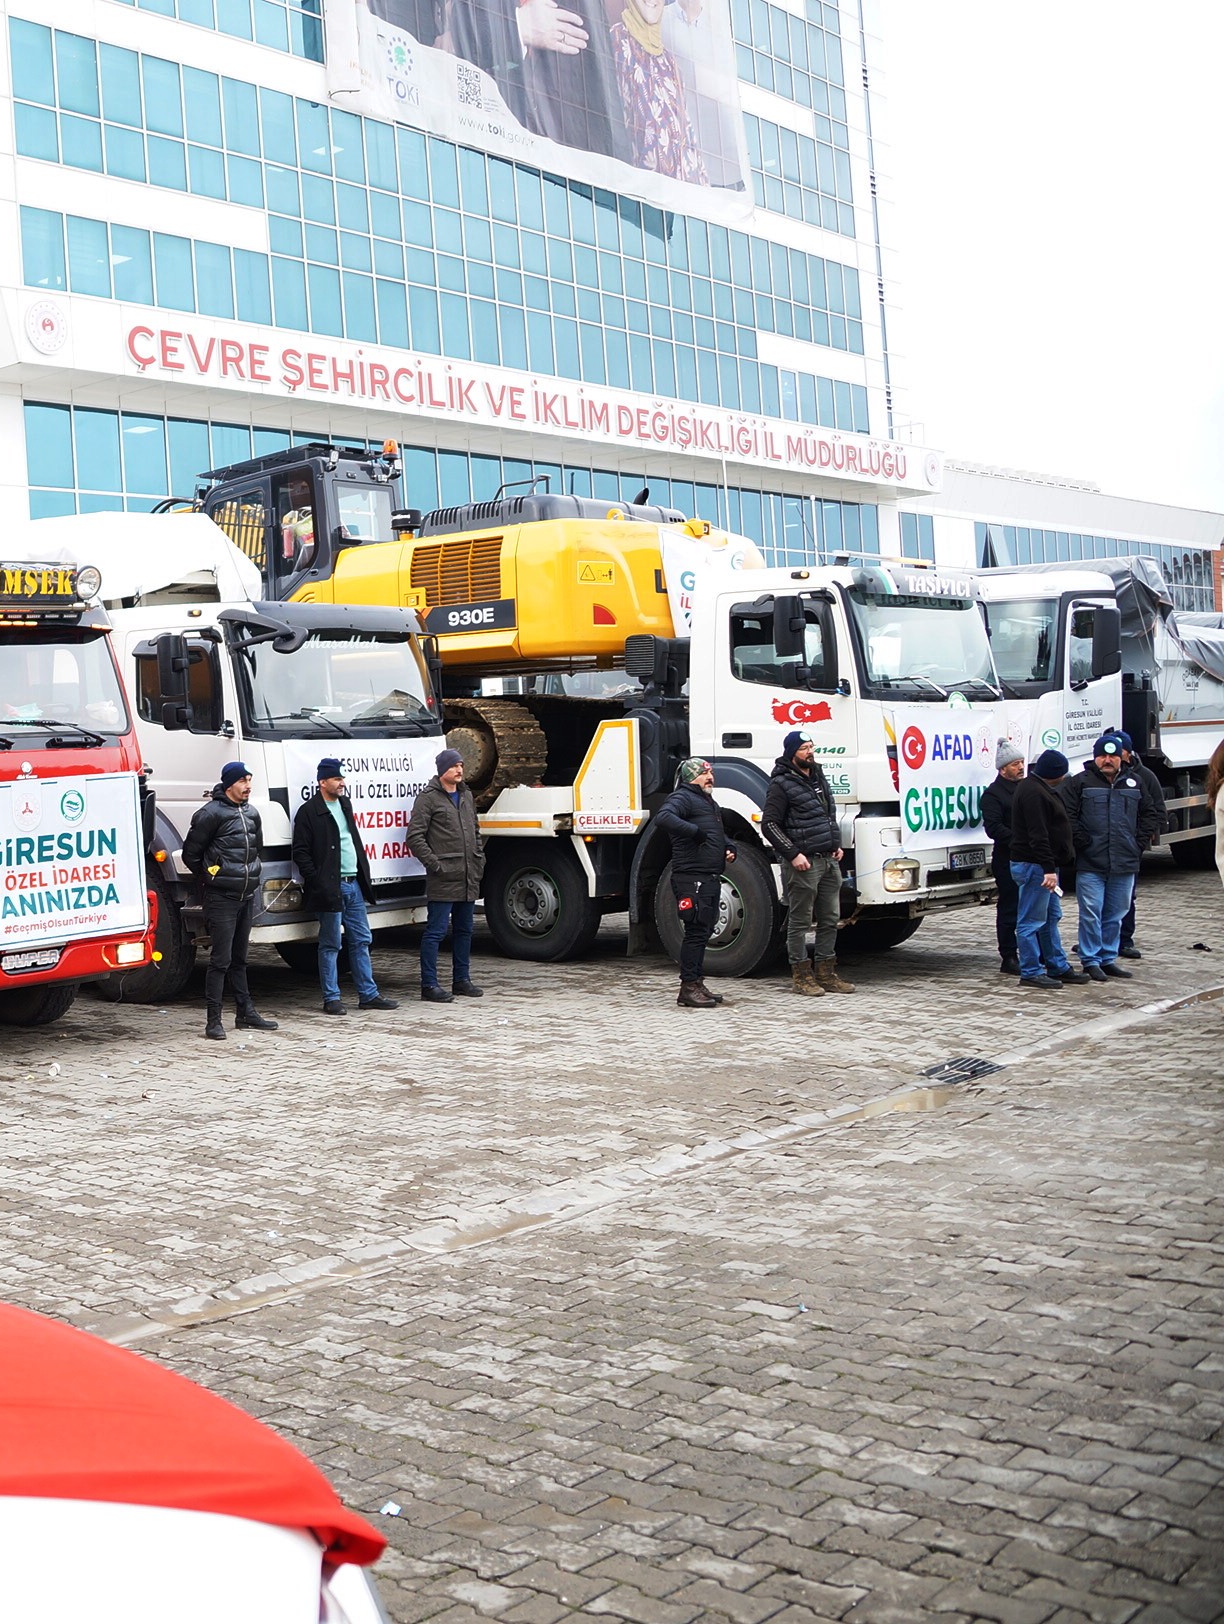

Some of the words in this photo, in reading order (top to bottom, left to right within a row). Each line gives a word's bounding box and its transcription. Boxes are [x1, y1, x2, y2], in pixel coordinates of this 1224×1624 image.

[127, 325, 272, 383] ÇEVRE
[279, 348, 479, 414] ŞEHİRCİLİK
[484, 383, 527, 421] VE
[533, 378, 611, 434] İKLİM
[616, 400, 760, 456] DEĞİŞİKLİĞİ
[761, 421, 782, 461] İL
[786, 429, 908, 480] MÜDÜRLÜĞÜ
[448, 607, 495, 627] 930E
[931, 733, 973, 761] AFAD
[371, 753, 414, 772] VALİLİĞİ
[355, 780, 365, 799] İL
[367, 779, 393, 799] ÖZEL
[396, 779, 428, 798] İDARES
[353, 810, 410, 829] MZEDEL
[904, 785, 989, 833] GİRESU
[381, 841, 412, 860] ARA
[5, 870, 48, 891] ÖZEL
[52, 858, 117, 886] İDARESİ
[4, 913, 108, 935] #GeçmişOlsunTürkiye
